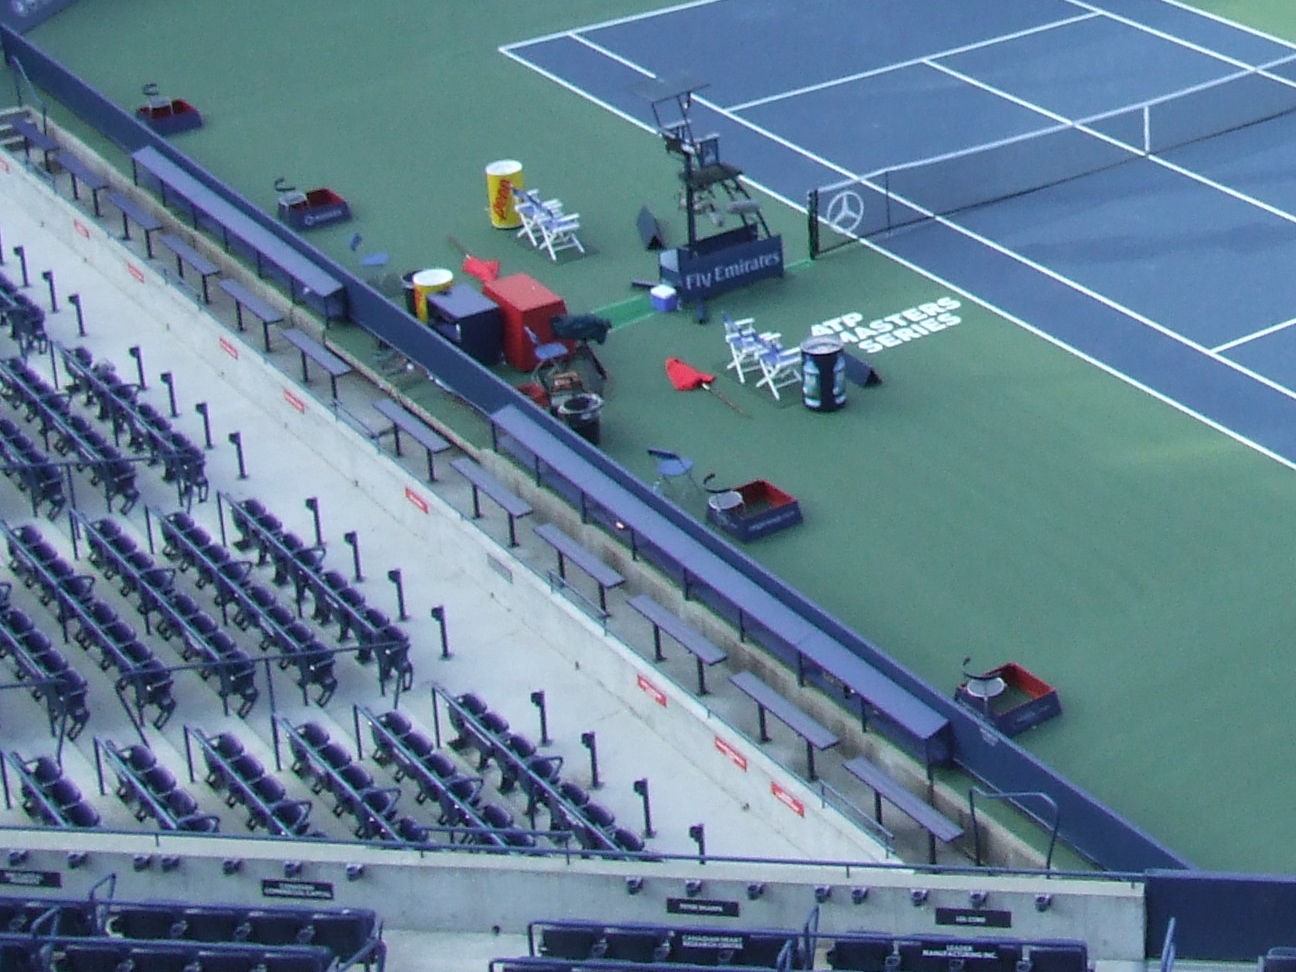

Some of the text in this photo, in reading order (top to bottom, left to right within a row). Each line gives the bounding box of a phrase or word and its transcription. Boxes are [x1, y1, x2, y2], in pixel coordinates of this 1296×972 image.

[686, 251, 780, 290] Fly Emirates
[811, 312, 864, 337] ATP
[858, 312, 963, 354] SERIES
